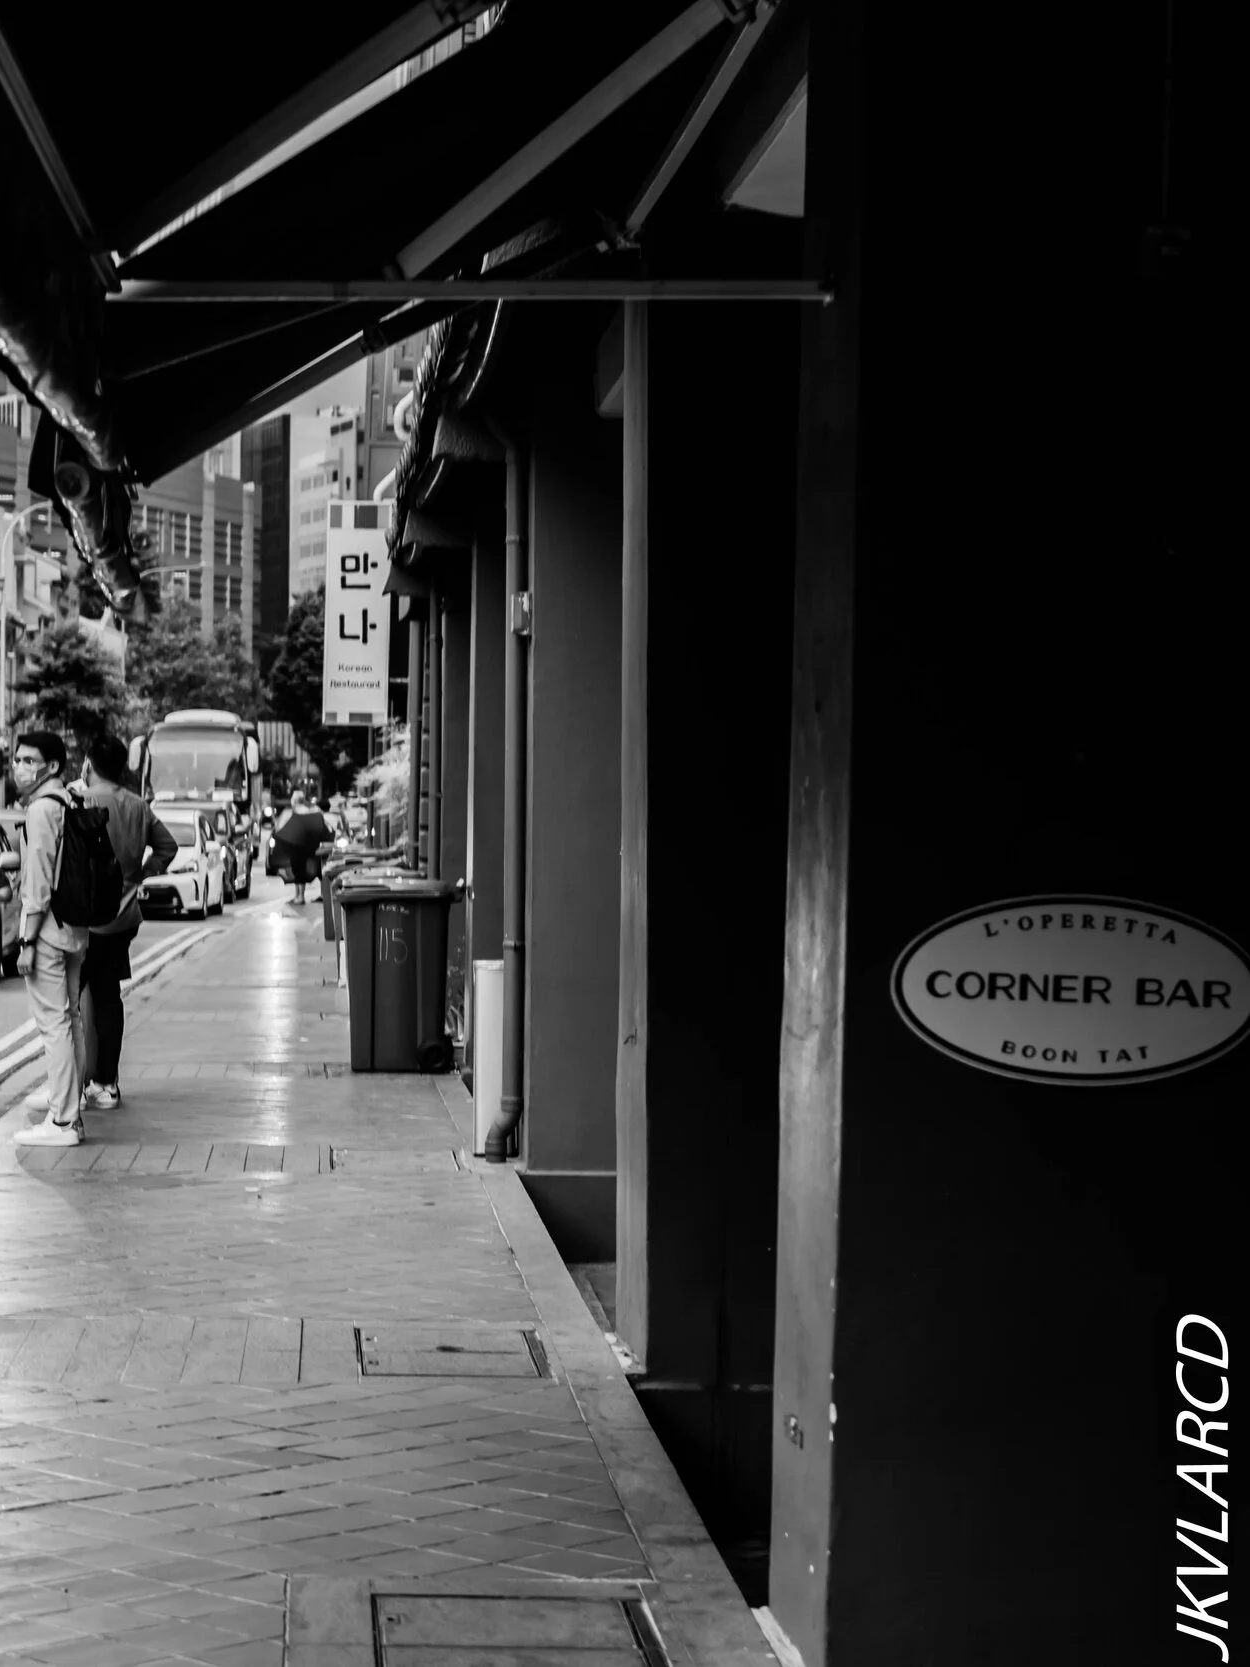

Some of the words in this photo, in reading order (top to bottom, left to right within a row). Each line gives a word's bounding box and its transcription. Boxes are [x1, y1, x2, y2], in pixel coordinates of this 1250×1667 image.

[338, 663, 373, 672] Korean
[330, 680, 381, 688] Restaurant
[983, 912, 1177, 945] L'OPERETTA
[379, 926, 409, 965] 115
[925, 970, 1112, 1005] CORNER
[1134, 977, 1233, 1009] BAR
[1000, 1039, 1079, 1064] BOON
[1096, 1045, 1150, 1064] TAT
